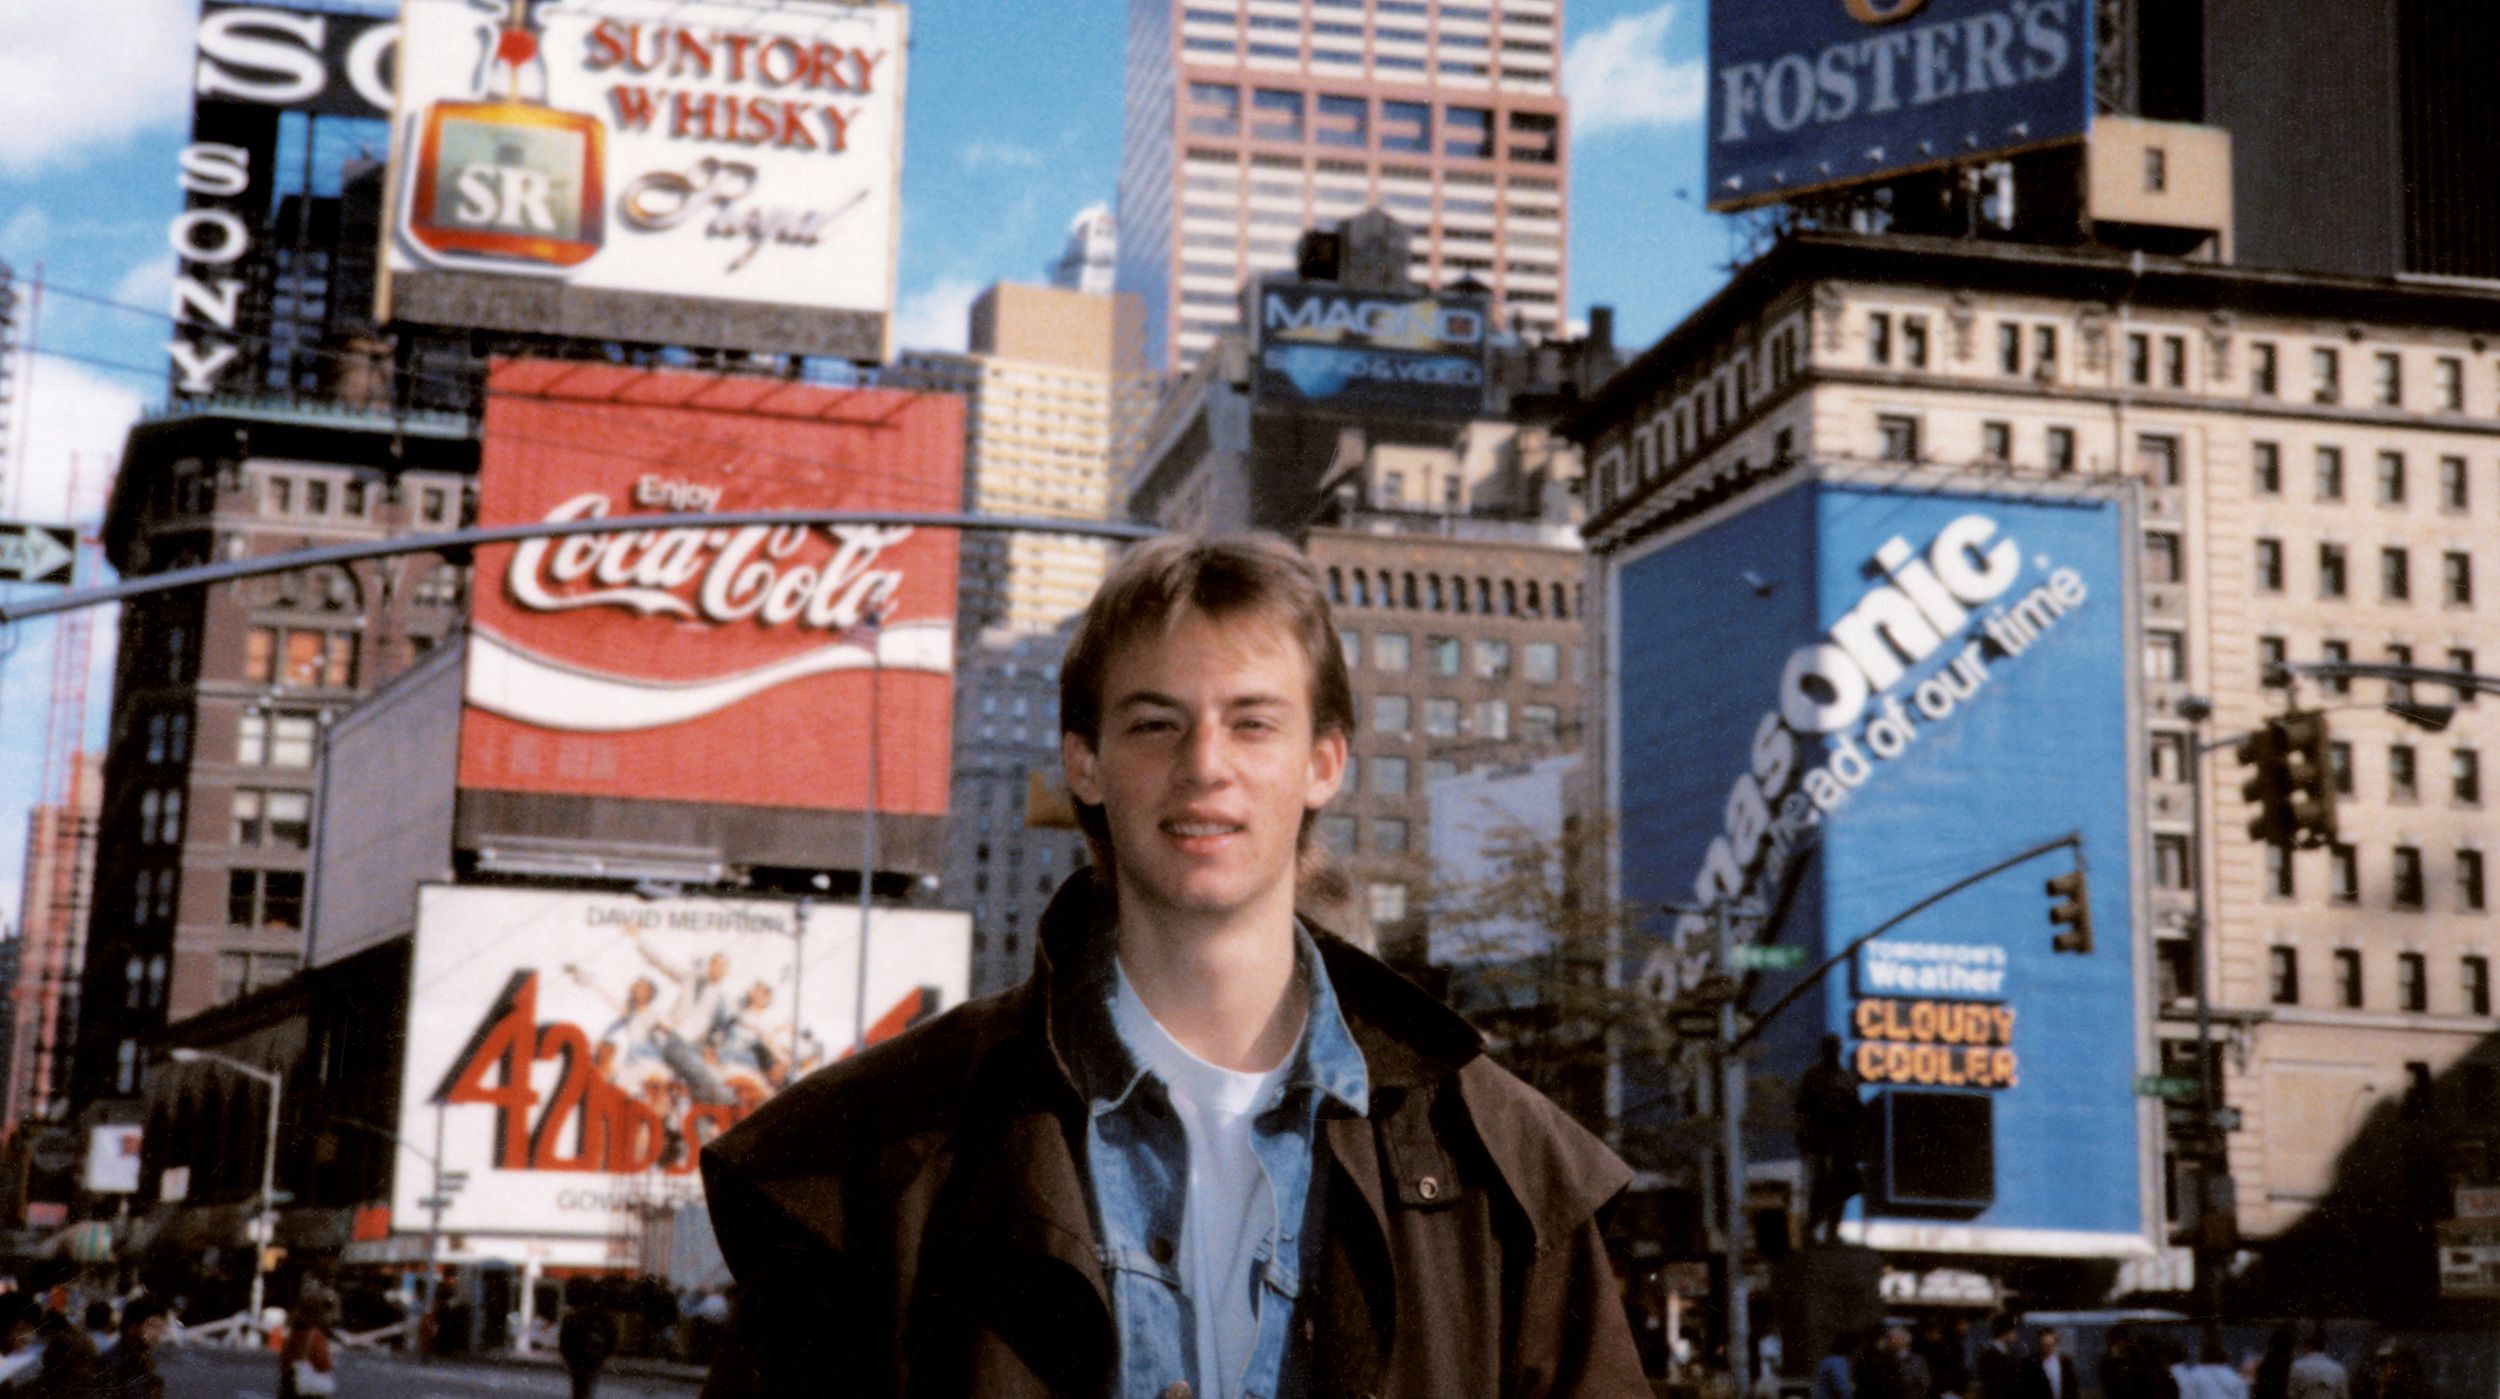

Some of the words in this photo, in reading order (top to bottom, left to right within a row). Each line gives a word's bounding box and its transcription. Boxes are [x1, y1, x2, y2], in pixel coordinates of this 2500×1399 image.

[587, 19, 886, 94] SUNTORY
[1719, 1, 2069, 142] FOSTER'S
[610, 84, 862, 151] WHISKY
[455, 163, 557, 232] SR
[166, 142, 249, 393] SONY
[1265, 293, 1483, 344] MAGNO
[638, 474, 722, 512] Enjoy
[0, 536, 46, 566] AY
[509, 493, 914, 630] Coca-Cola
[1865, 697, 1917, 760] of
[1914, 636, 1989, 720] our
[1986, 566, 2087, 659] time
[586, 905, 661, 929] DAVID
[1868, 961, 2006, 992] Weather
[1856, 998, 2016, 1044] CLOUDY
[1857, 1041, 2018, 1088] COOLER
